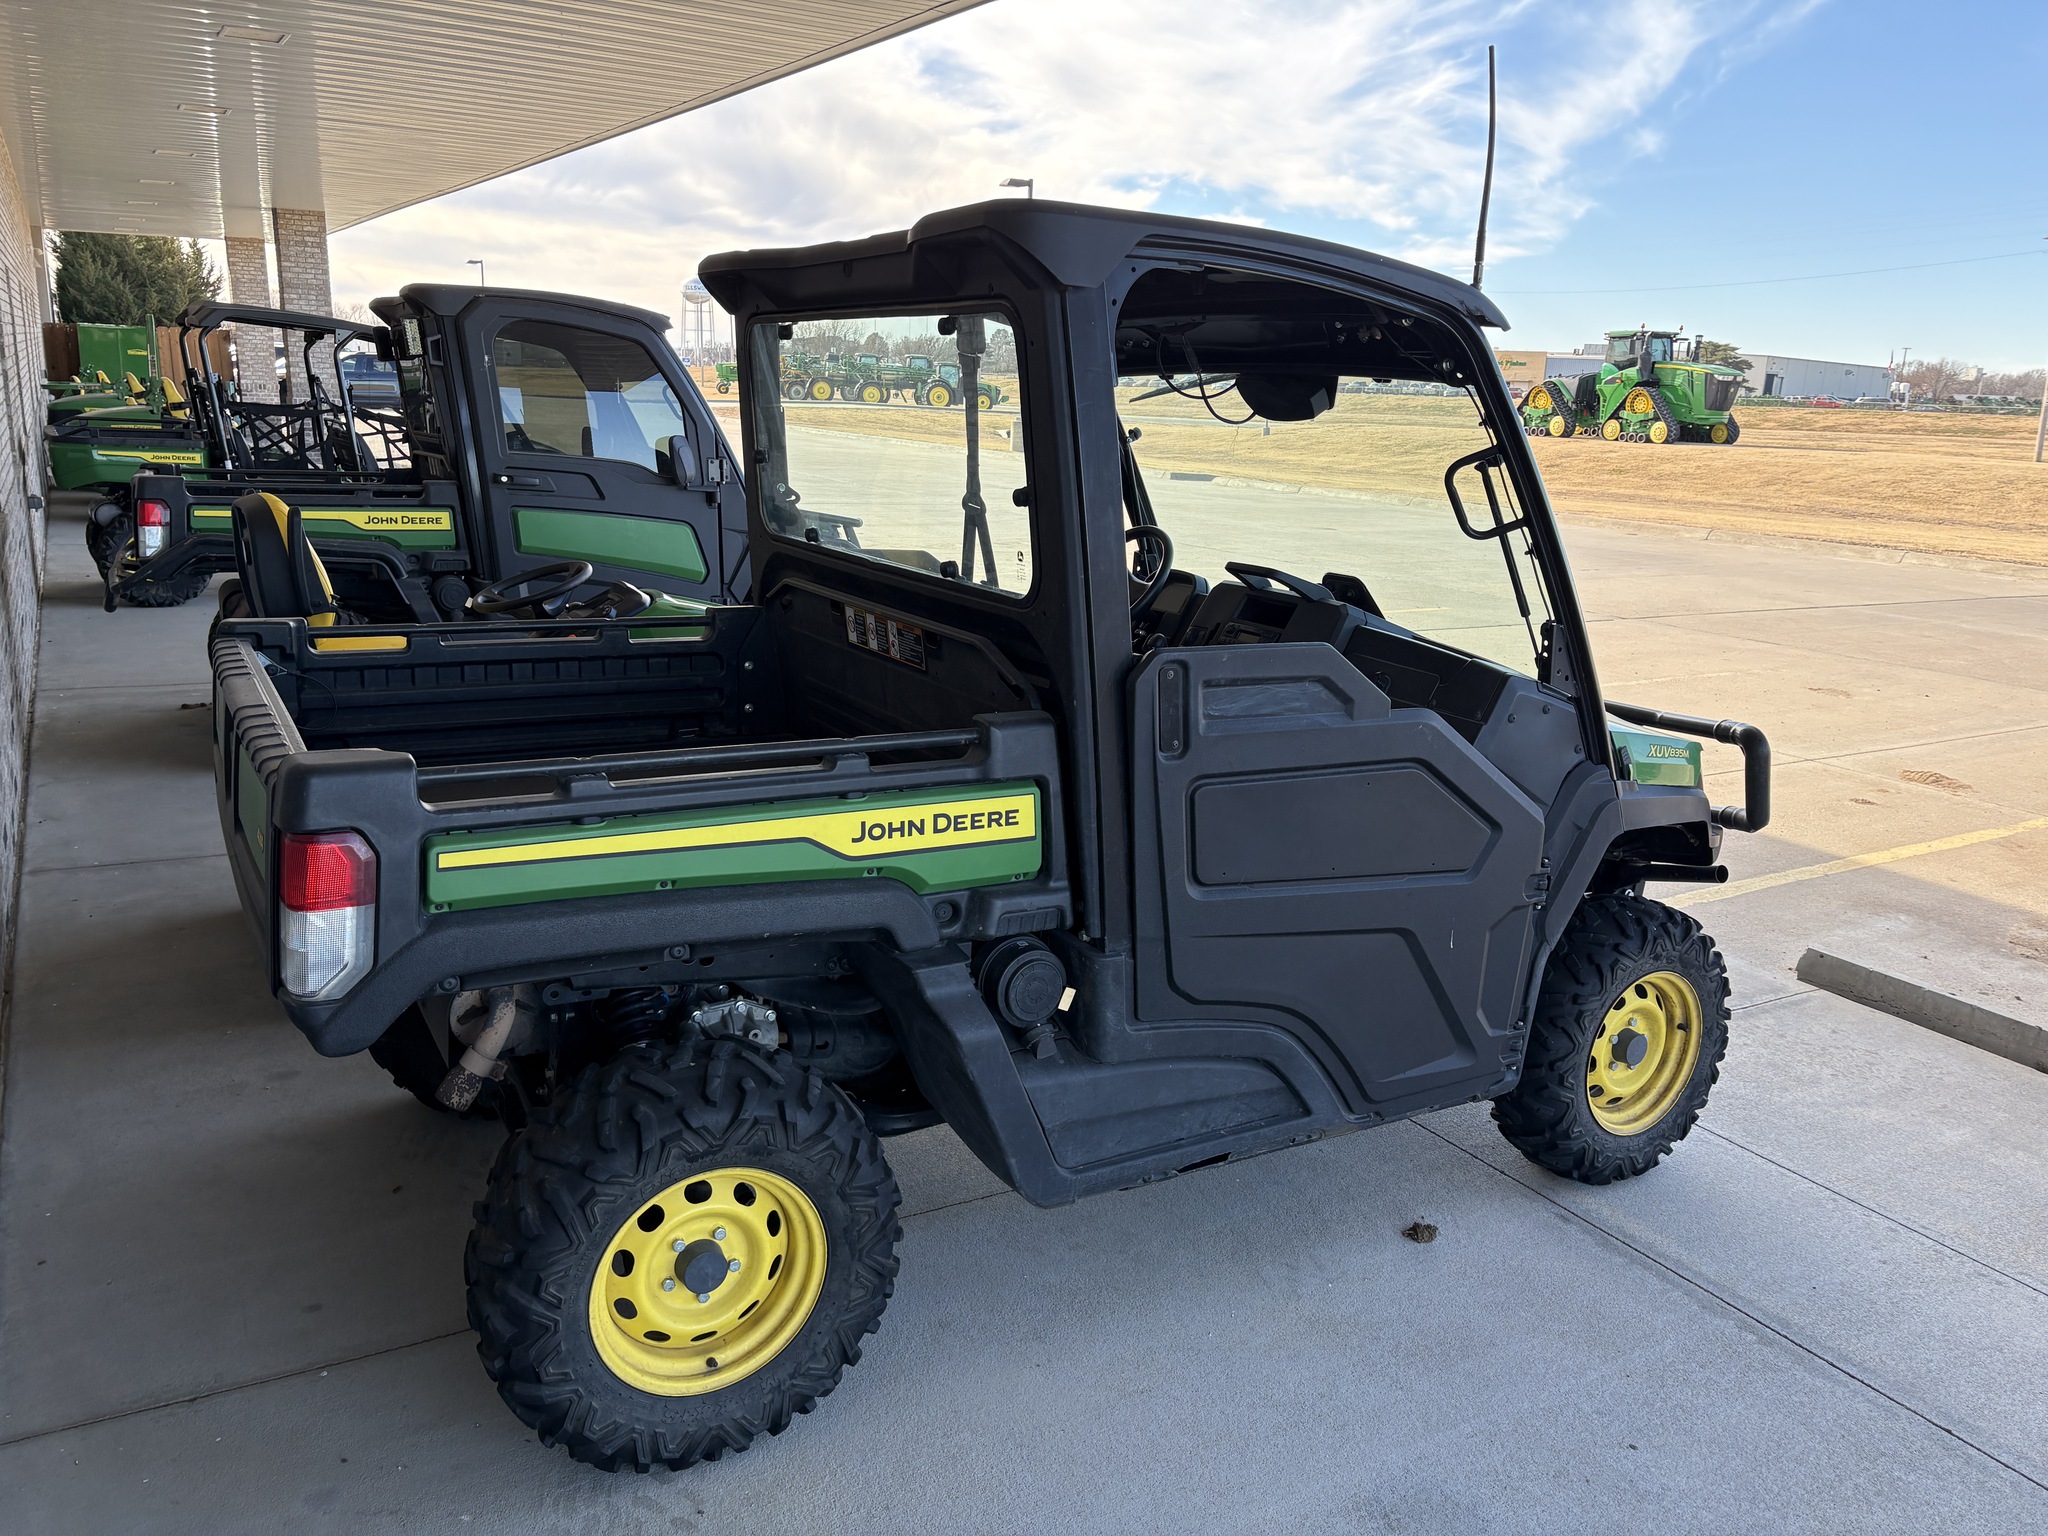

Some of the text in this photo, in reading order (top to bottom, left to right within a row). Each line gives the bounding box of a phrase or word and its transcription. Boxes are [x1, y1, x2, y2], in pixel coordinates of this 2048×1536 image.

[364, 515, 443, 525] JOHN DEERE
[1647, 744, 1690, 758] XUV835M
[851, 808, 1020, 844] JOHN DEERE
